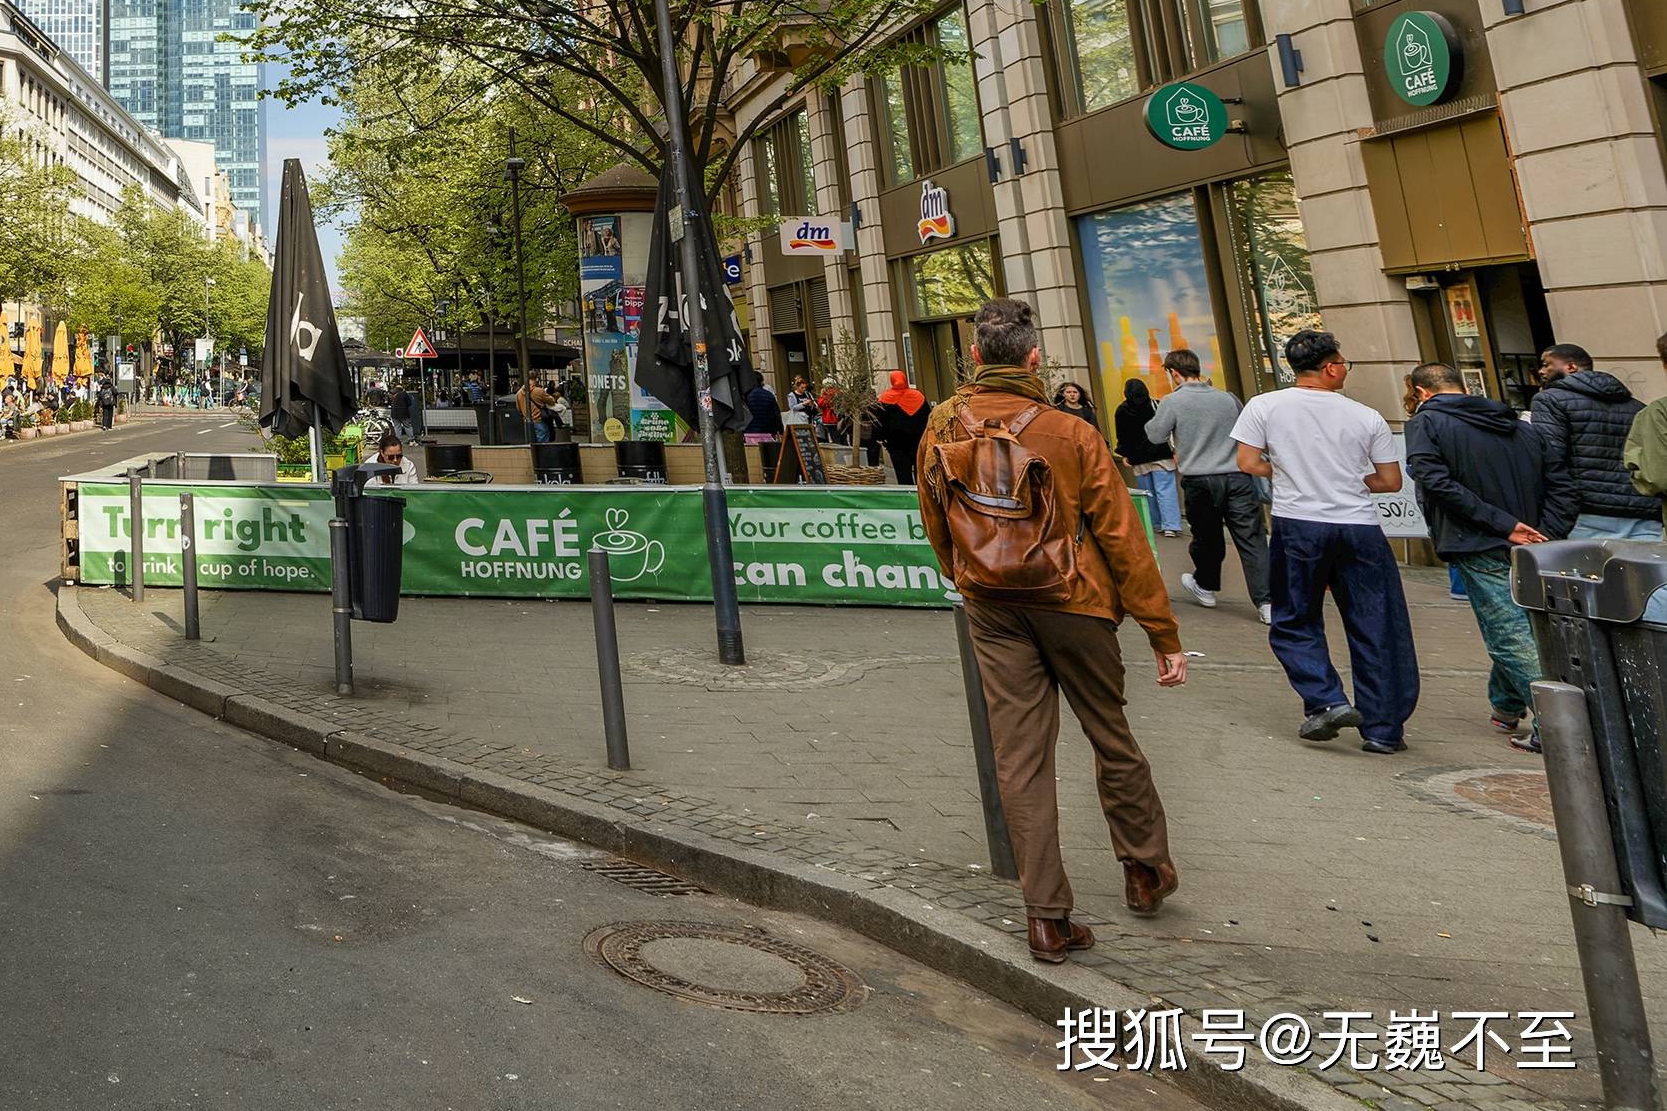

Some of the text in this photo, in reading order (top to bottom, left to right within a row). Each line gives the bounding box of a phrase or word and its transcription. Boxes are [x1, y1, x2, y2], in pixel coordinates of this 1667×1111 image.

[1405, 68, 1436, 90] CAFÉ
[1407, 84, 1438, 97] HOFFNUNG
[1172, 125, 1210, 137] CAFÉ
[923, 187, 944, 219] dm
[796, 222, 830, 239] dm
[1378, 501, 1415, 518] 50%
[204, 507, 307, 551] right
[455, 507, 581, 556] CAFÉ
[729, 513, 790, 538] Your
[801, 513, 896, 539] coffee
[108, 557, 316, 581] to rink cup of hope.
[461, 561, 582, 580] HOFFNUNG
[733, 561, 807, 586] can
